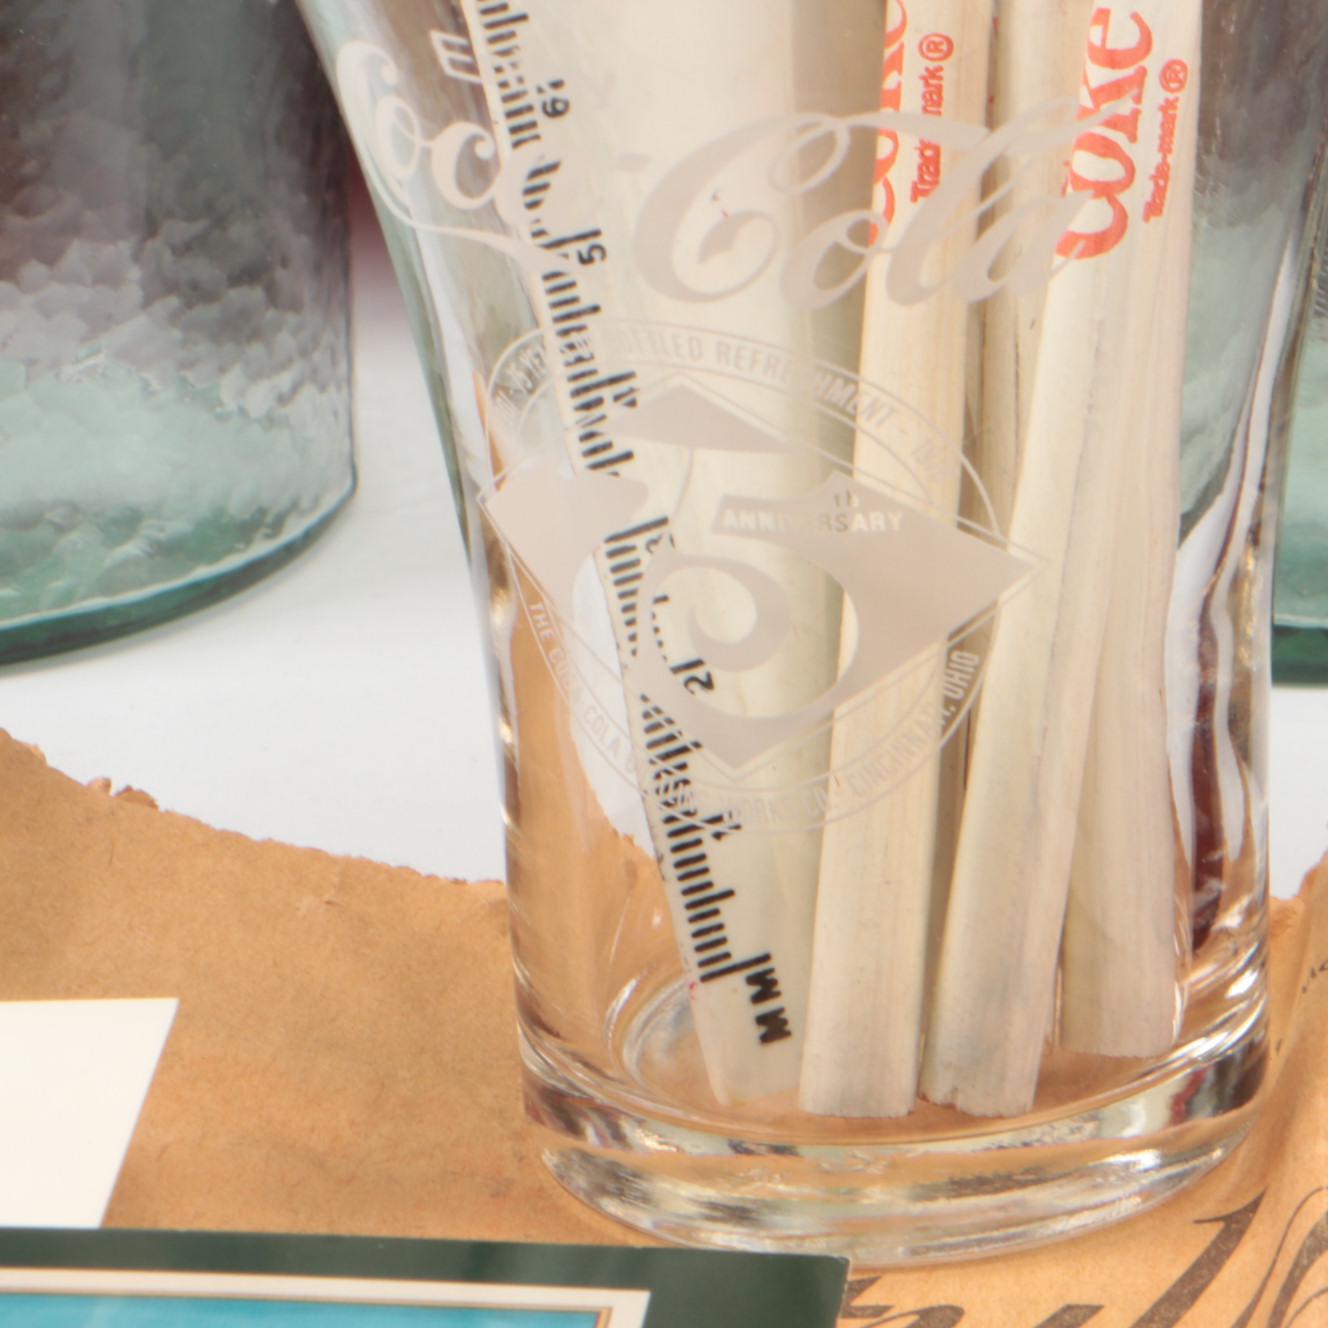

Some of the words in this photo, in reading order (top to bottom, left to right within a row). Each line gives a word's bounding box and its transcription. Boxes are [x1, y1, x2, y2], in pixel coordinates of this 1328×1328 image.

[541, 96, 570, 119] 6
[1055, 7, 1153, 260] Coke
[577, 242, 607, 267] 5
[683, 669, 716, 695] 2
